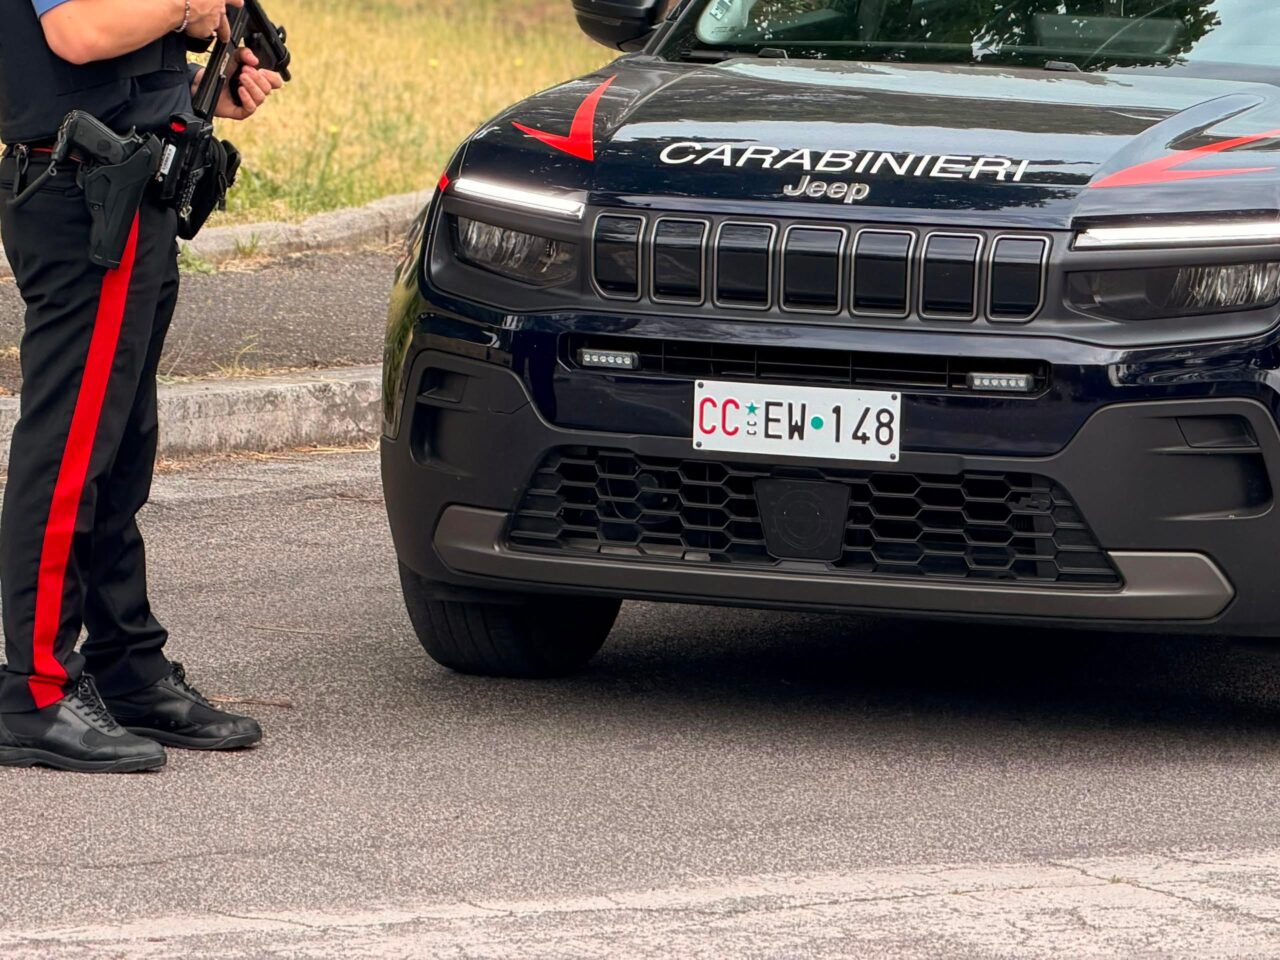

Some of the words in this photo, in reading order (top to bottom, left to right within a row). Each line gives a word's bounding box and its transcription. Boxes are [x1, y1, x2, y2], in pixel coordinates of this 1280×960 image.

[659, 142, 1030, 182] CARABINIERI
[783, 175, 870, 203] Jeep
[699, 397, 740, 436] CC
[764, 401, 806, 440] EW
[832, 405, 895, 445] 148
